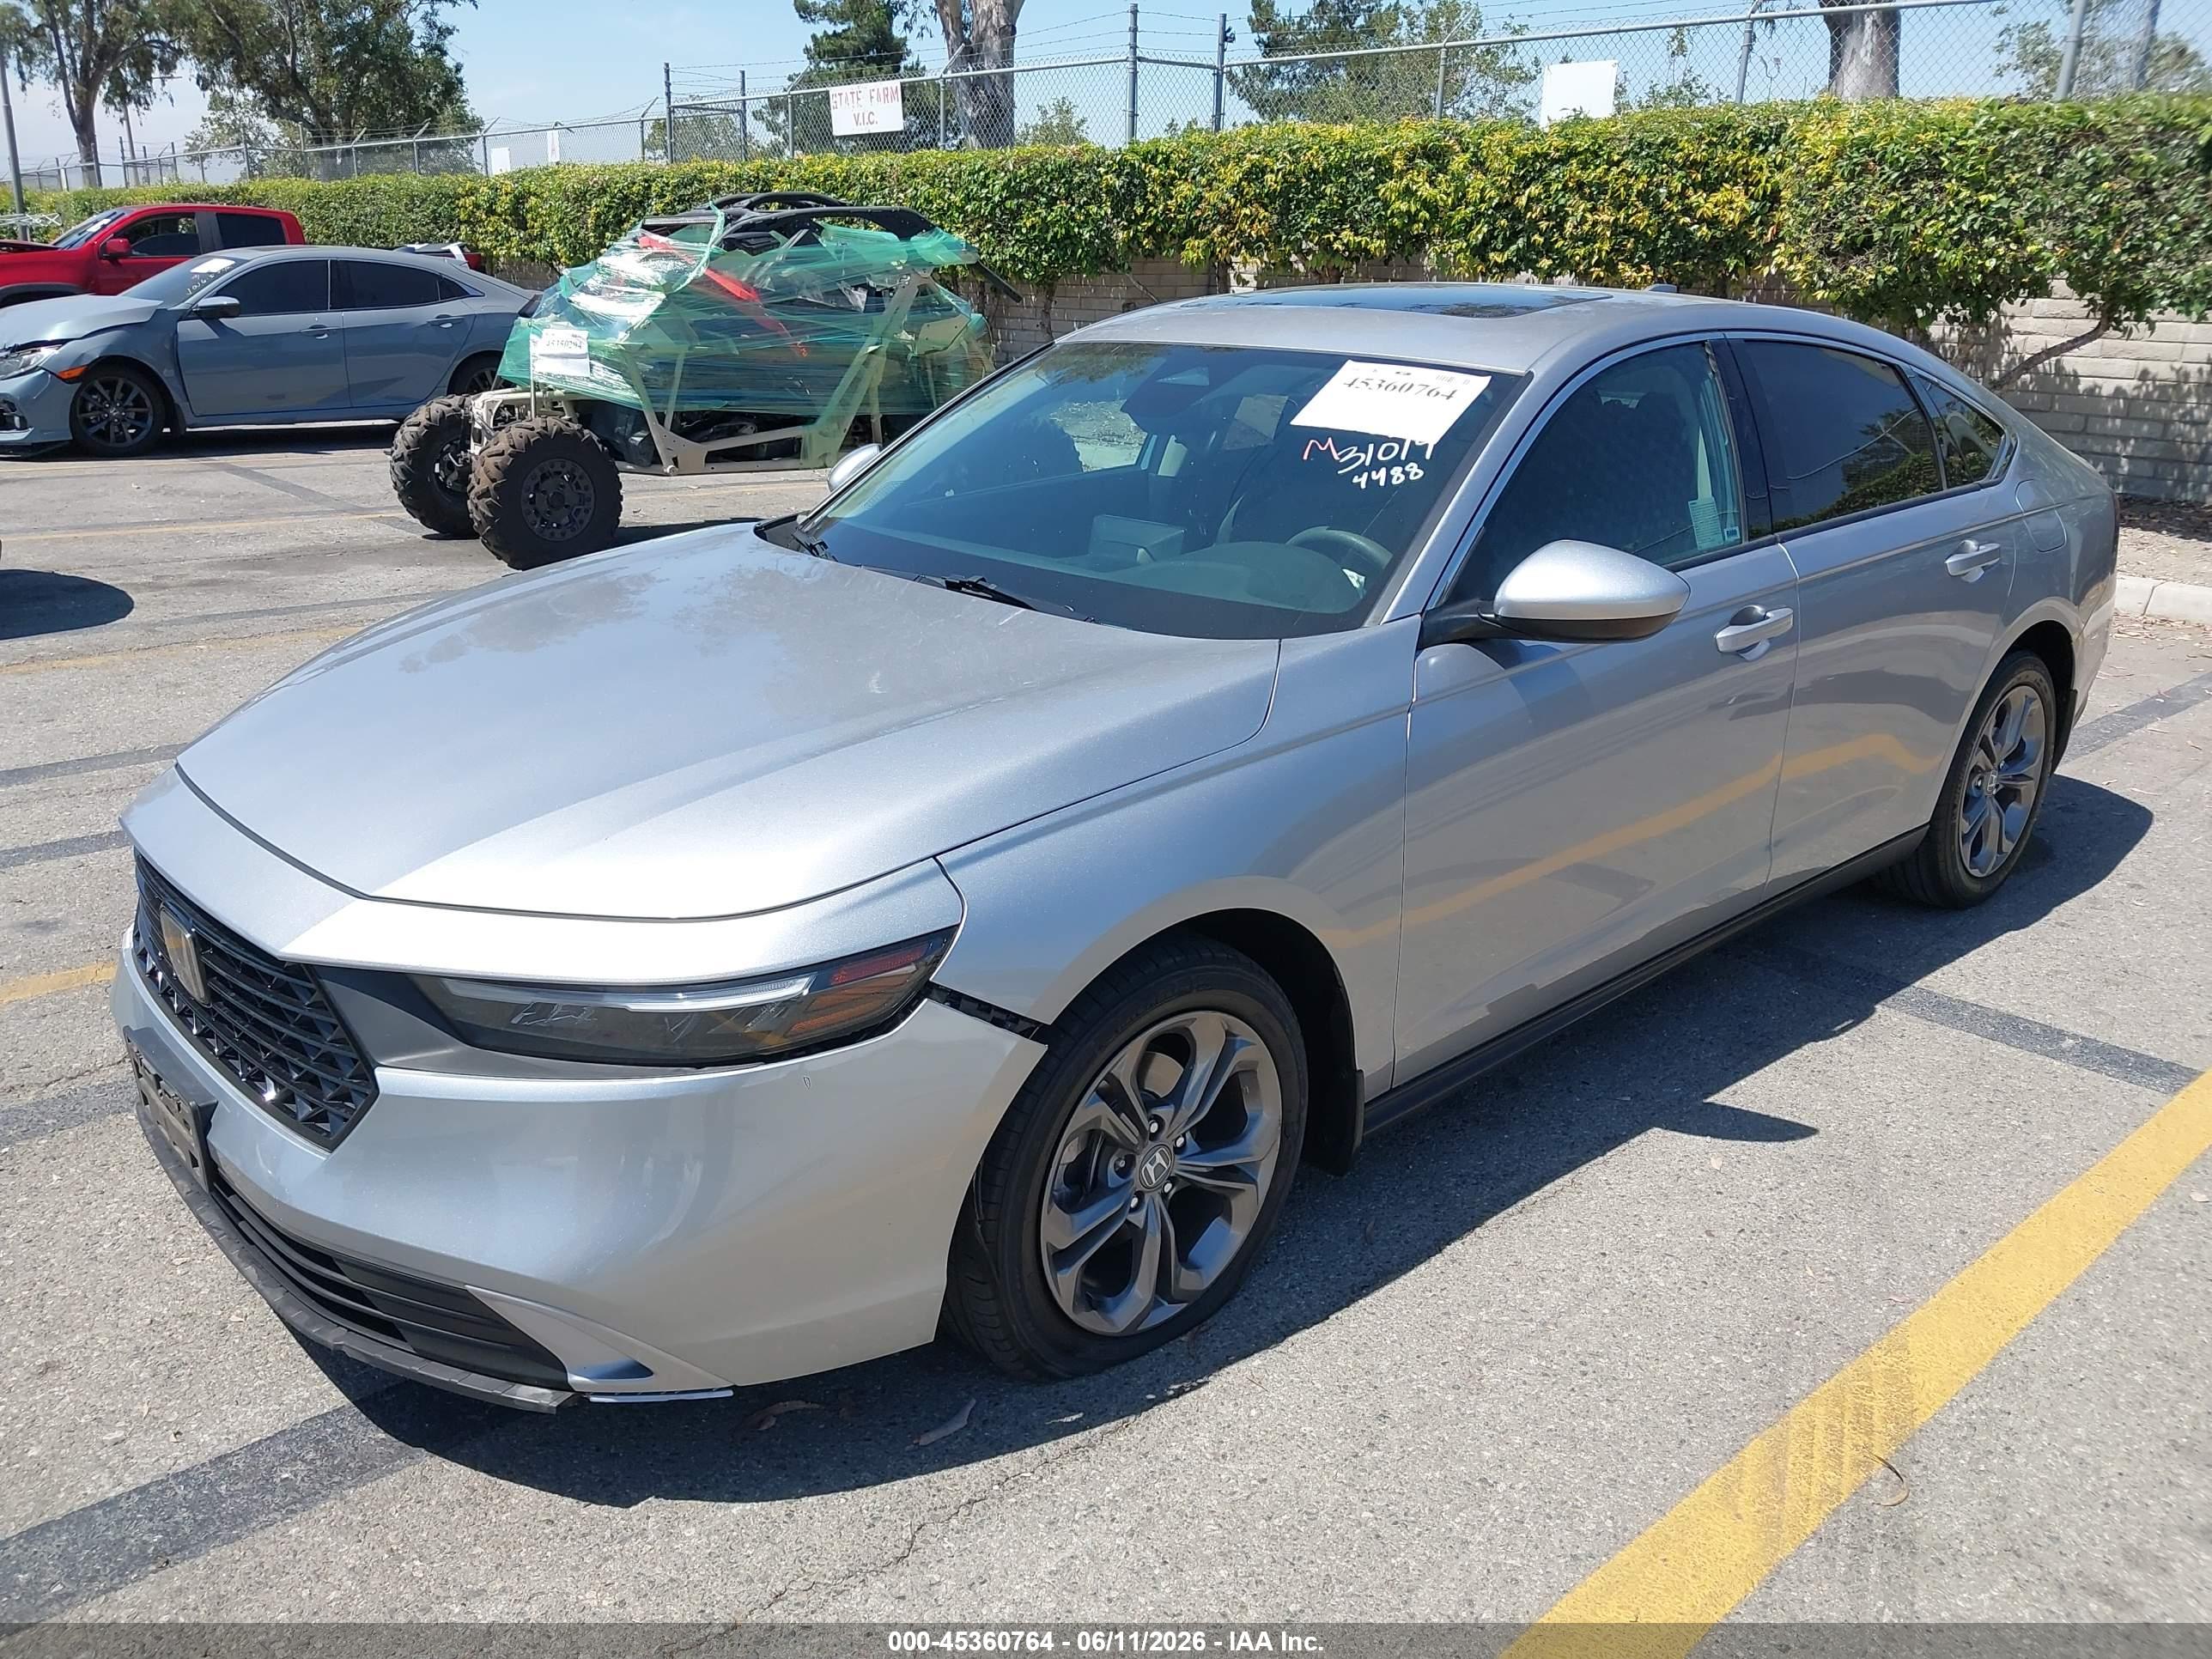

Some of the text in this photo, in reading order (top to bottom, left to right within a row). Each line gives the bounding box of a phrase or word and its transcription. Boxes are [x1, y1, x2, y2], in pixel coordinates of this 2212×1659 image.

[831, 86, 900, 110] STATE FARM
[853, 112, 878, 126] V.I.C.
[1343, 377, 1458, 400] 45360764
[1352, 462, 1425, 489] 4488
